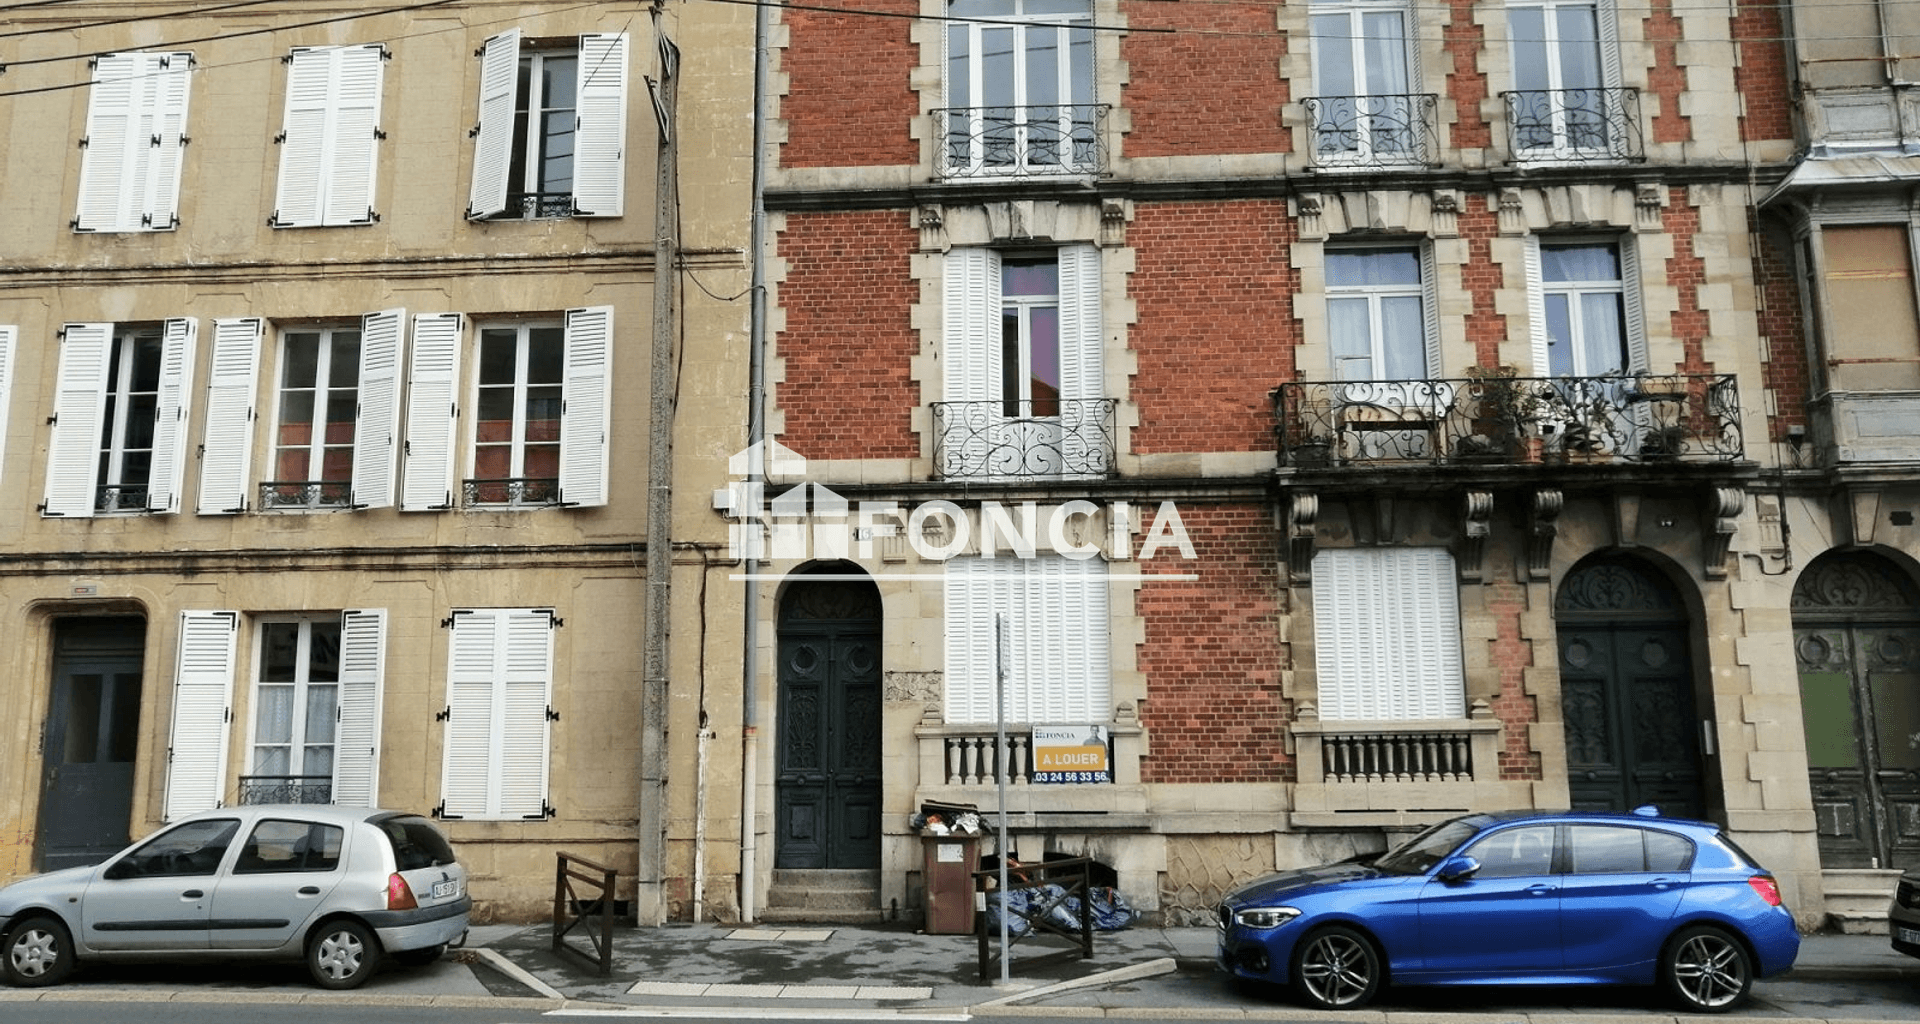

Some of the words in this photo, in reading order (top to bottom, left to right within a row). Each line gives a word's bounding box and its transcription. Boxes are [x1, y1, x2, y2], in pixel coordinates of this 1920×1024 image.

[1042, 753, 1052, 765] A
[1055, 753, 1099, 765] LOUER
[1035, 772, 1048, 781] 03
[1050, 772, 1063, 781] 24
[1065, 772, 1077, 781] 56
[1080, 772, 1092, 781] 33
[1094, 772, 1107, 781] 56
